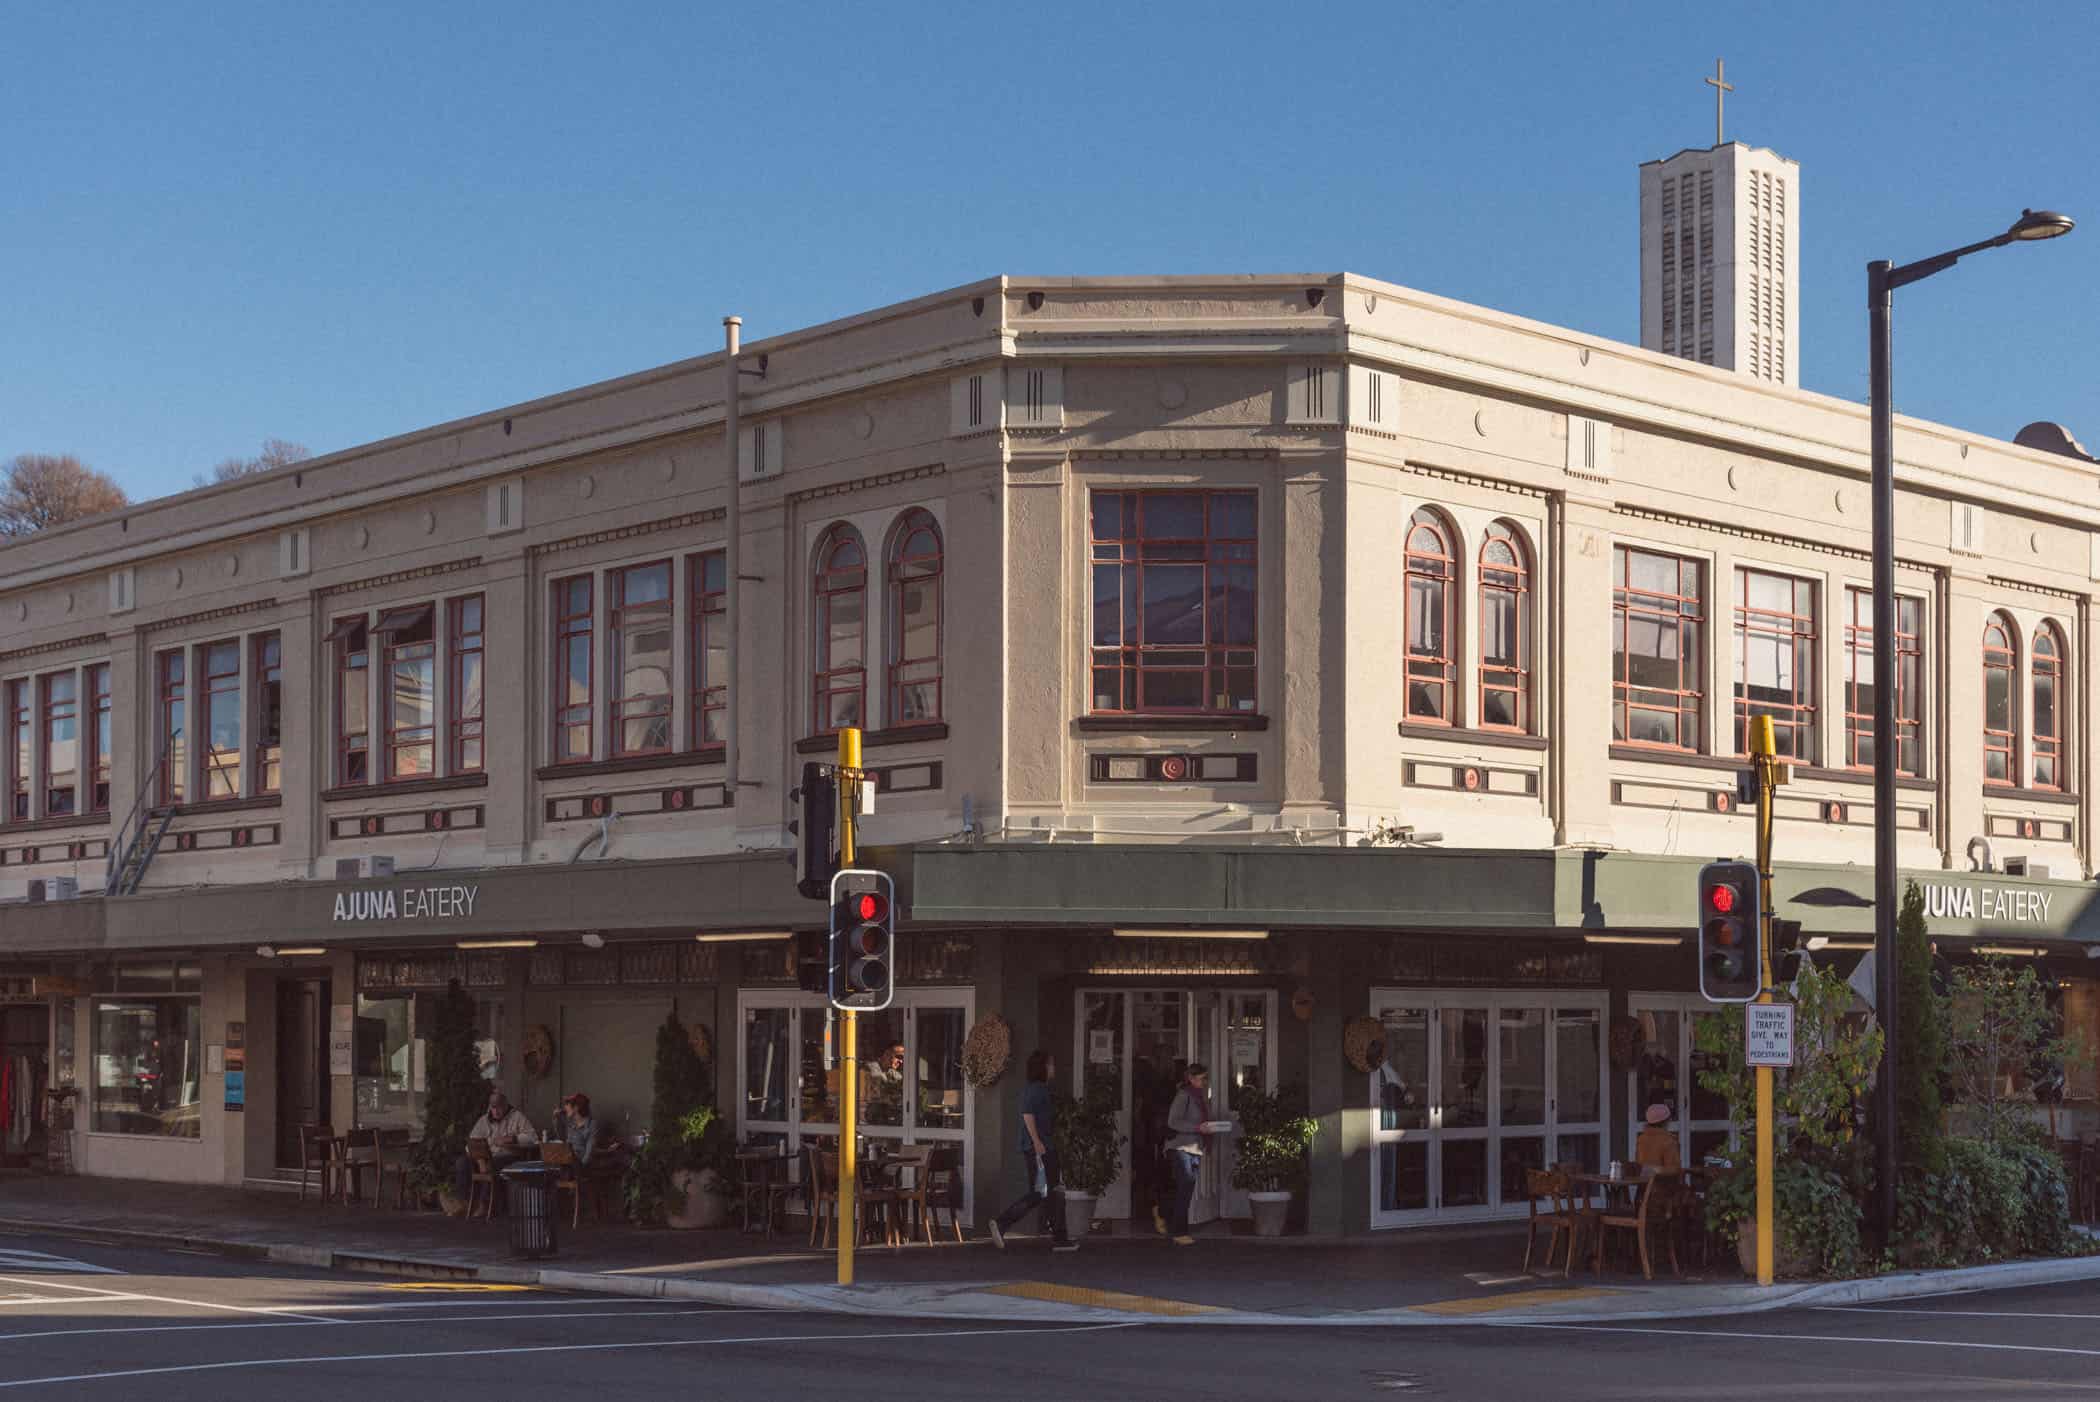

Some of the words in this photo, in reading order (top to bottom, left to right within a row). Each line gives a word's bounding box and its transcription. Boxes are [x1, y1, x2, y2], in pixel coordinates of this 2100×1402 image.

[333, 889, 397, 921] AJUNA
[403, 885, 478, 918] EATERY
[1922, 884, 1976, 919] JUNA
[1981, 887, 2053, 922] EATERY
[1755, 1011, 1786, 1020] TURNING
[1755, 1021, 1785, 1030] TRAFFIC
[1751, 1031, 1767, 1040] GIVE
[1774, 1031, 1788, 1040] WAY
[1765, 1040, 1774, 1049] TO
